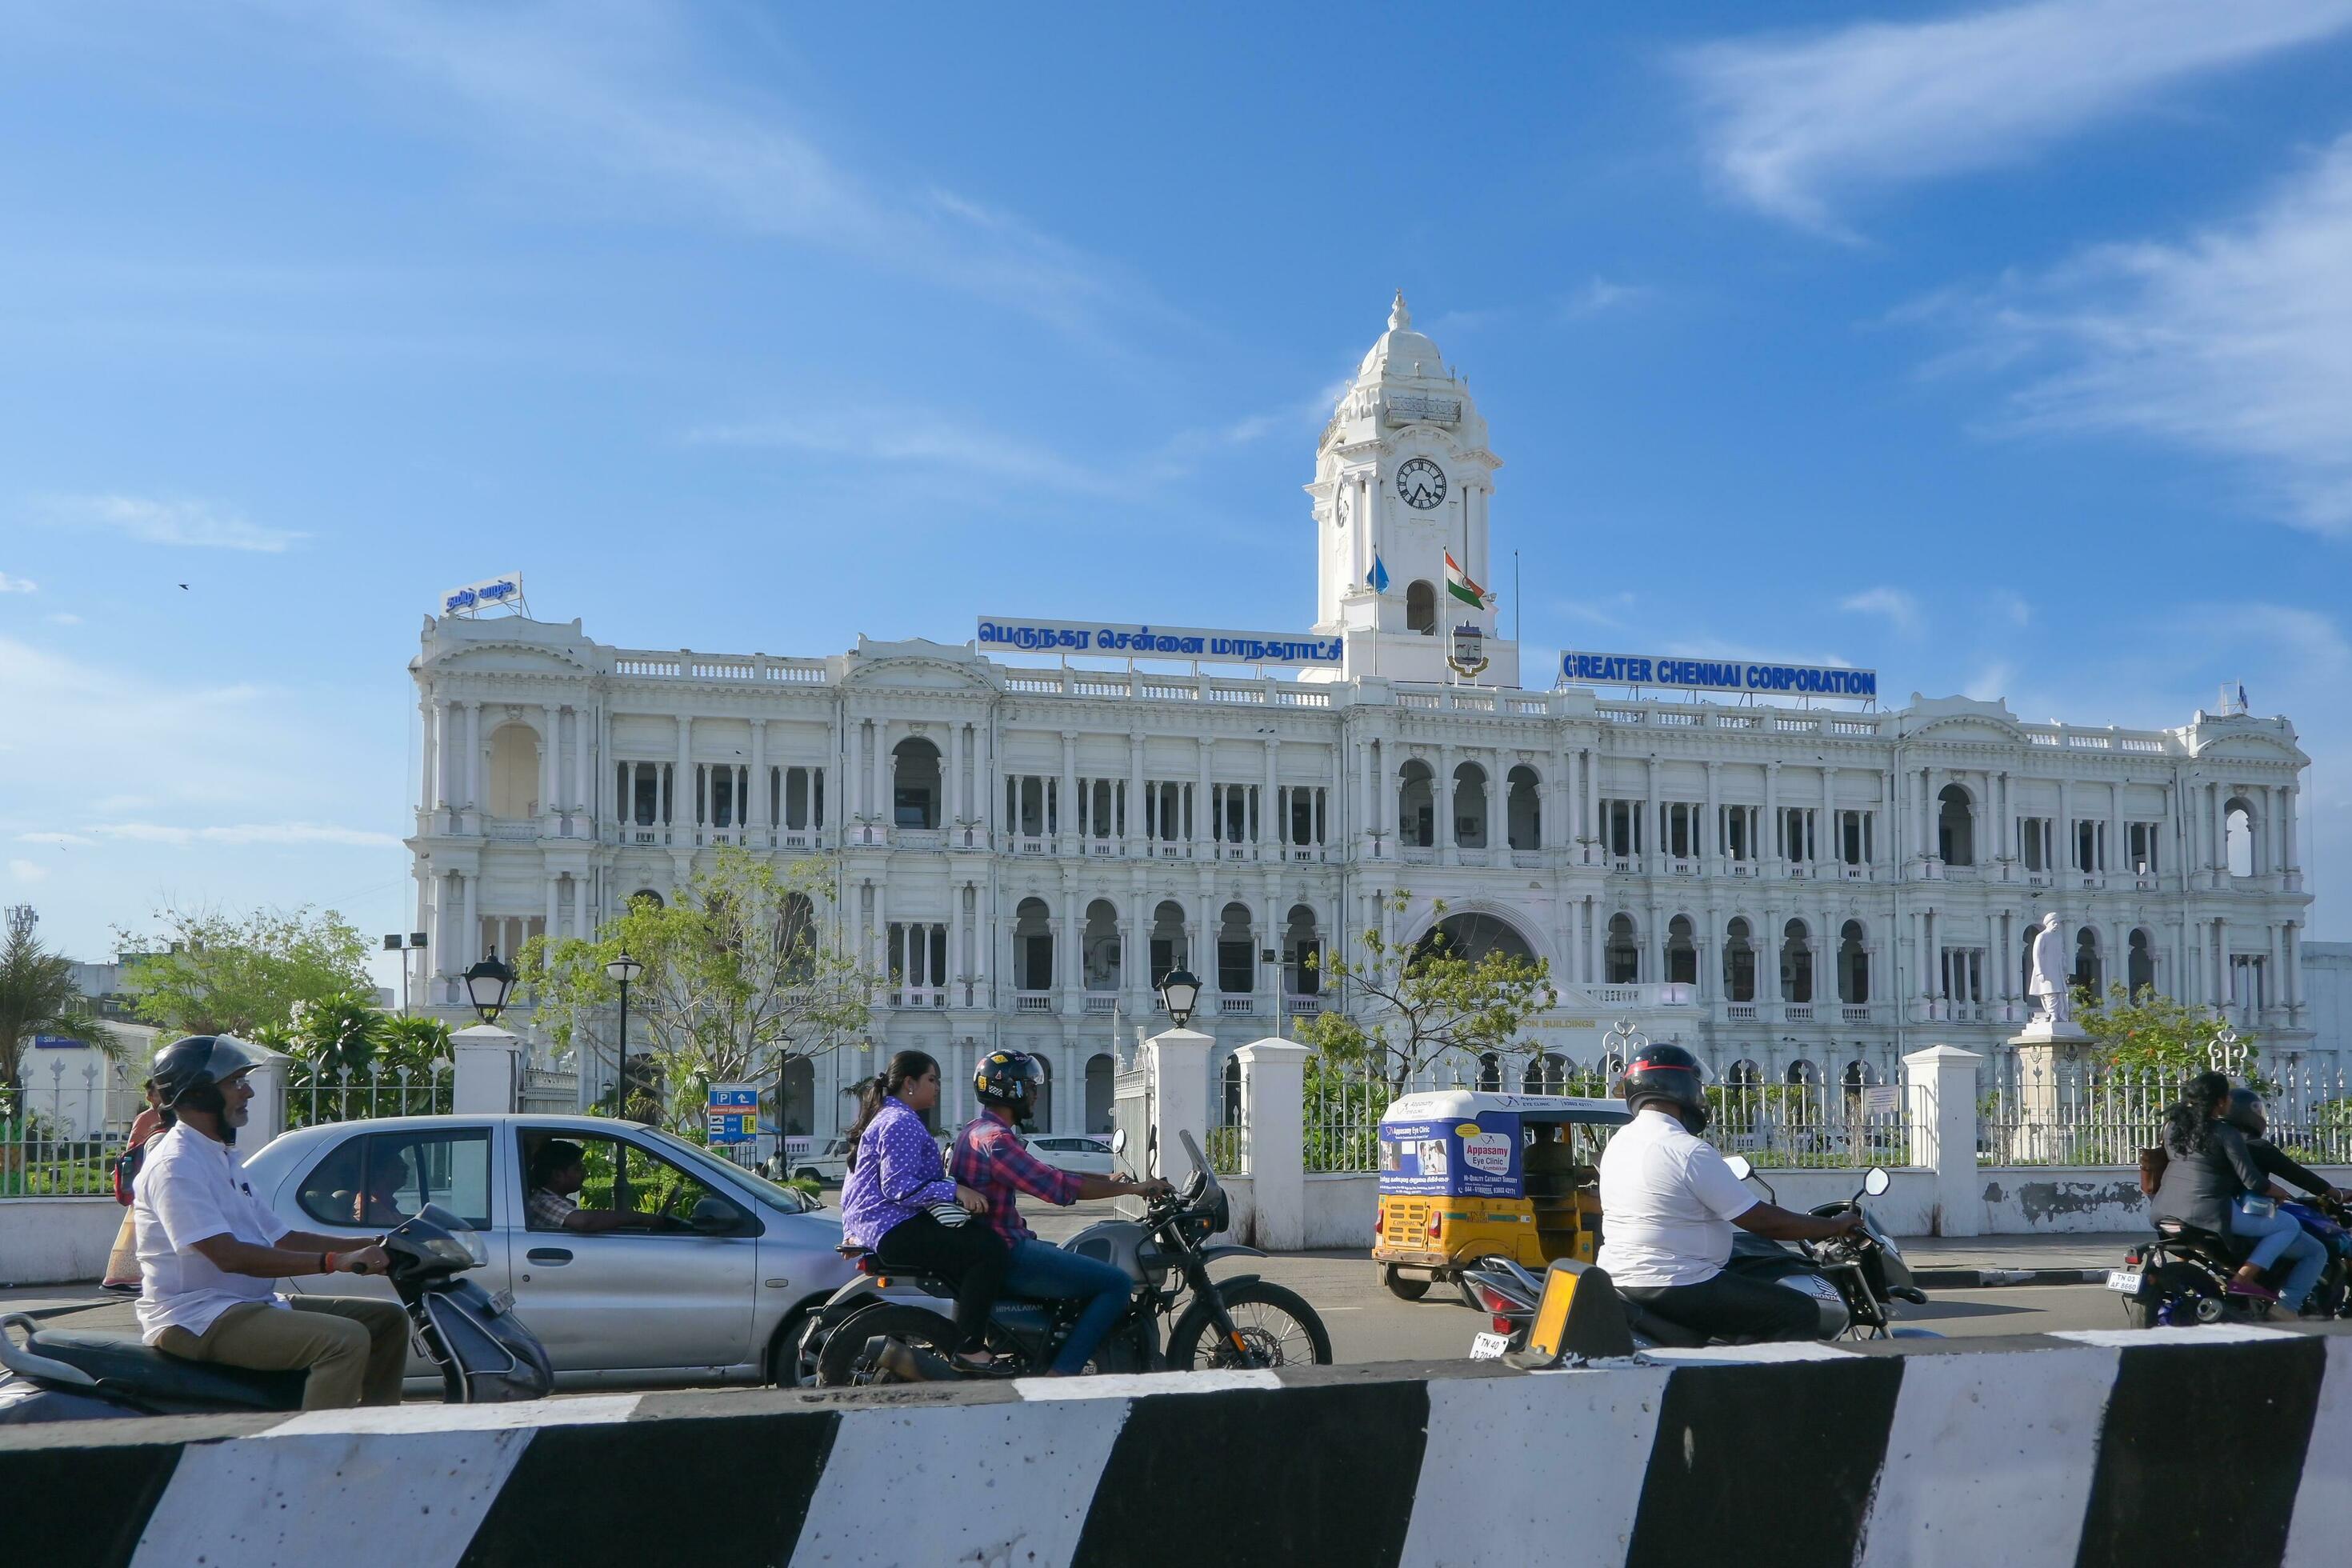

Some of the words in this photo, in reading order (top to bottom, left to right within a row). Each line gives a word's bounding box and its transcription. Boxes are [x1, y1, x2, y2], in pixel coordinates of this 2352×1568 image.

[978, 622, 1090, 650] பெருநகர
[1097, 626, 1204, 654] சென்னை
[1210, 638, 1342, 662] மாநகராட்சி
[1563, 654, 1652, 682] GREATER
[1657, 660, 1741, 687] CHENNAI
[1746, 665, 1875, 695] CORPORATION
[1542, 1019, 1596, 1028] BUILDINGS
[1466, 1145, 1508, 1157] Appasamy
[1473, 1157, 1485, 1166] Eye
[1486, 1158, 1503, 1166] Clinic
[1811, 1292, 1842, 1302] HONDA
[995, 1304, 1043, 1313] HIMALAYAN
[1481, 1338, 1491, 1347] TN
[1491, 1341, 1499, 1350] 40
